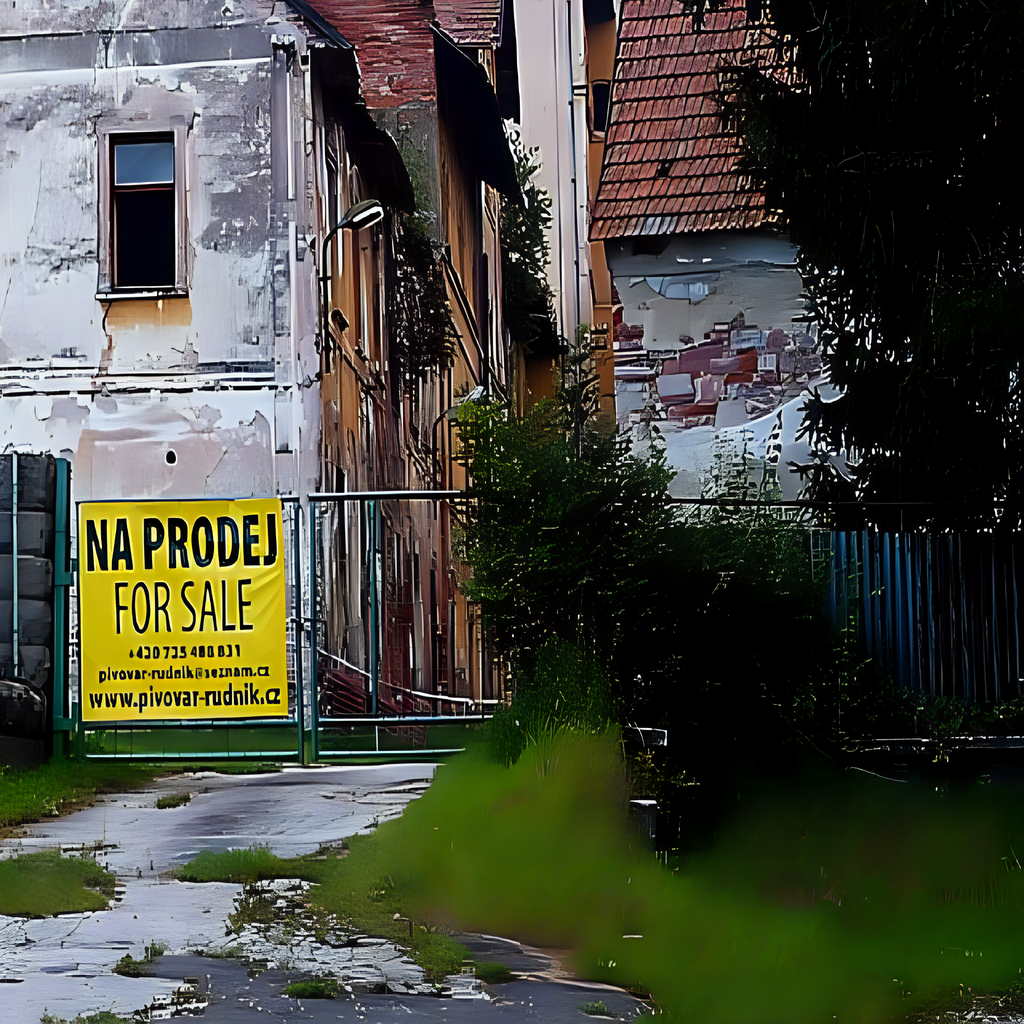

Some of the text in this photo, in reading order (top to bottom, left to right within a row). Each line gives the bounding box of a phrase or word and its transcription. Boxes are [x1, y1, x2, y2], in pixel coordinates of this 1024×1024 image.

[85, 513, 278, 572] NA PRODEJ
[114, 578, 254, 634] FOR SALE
